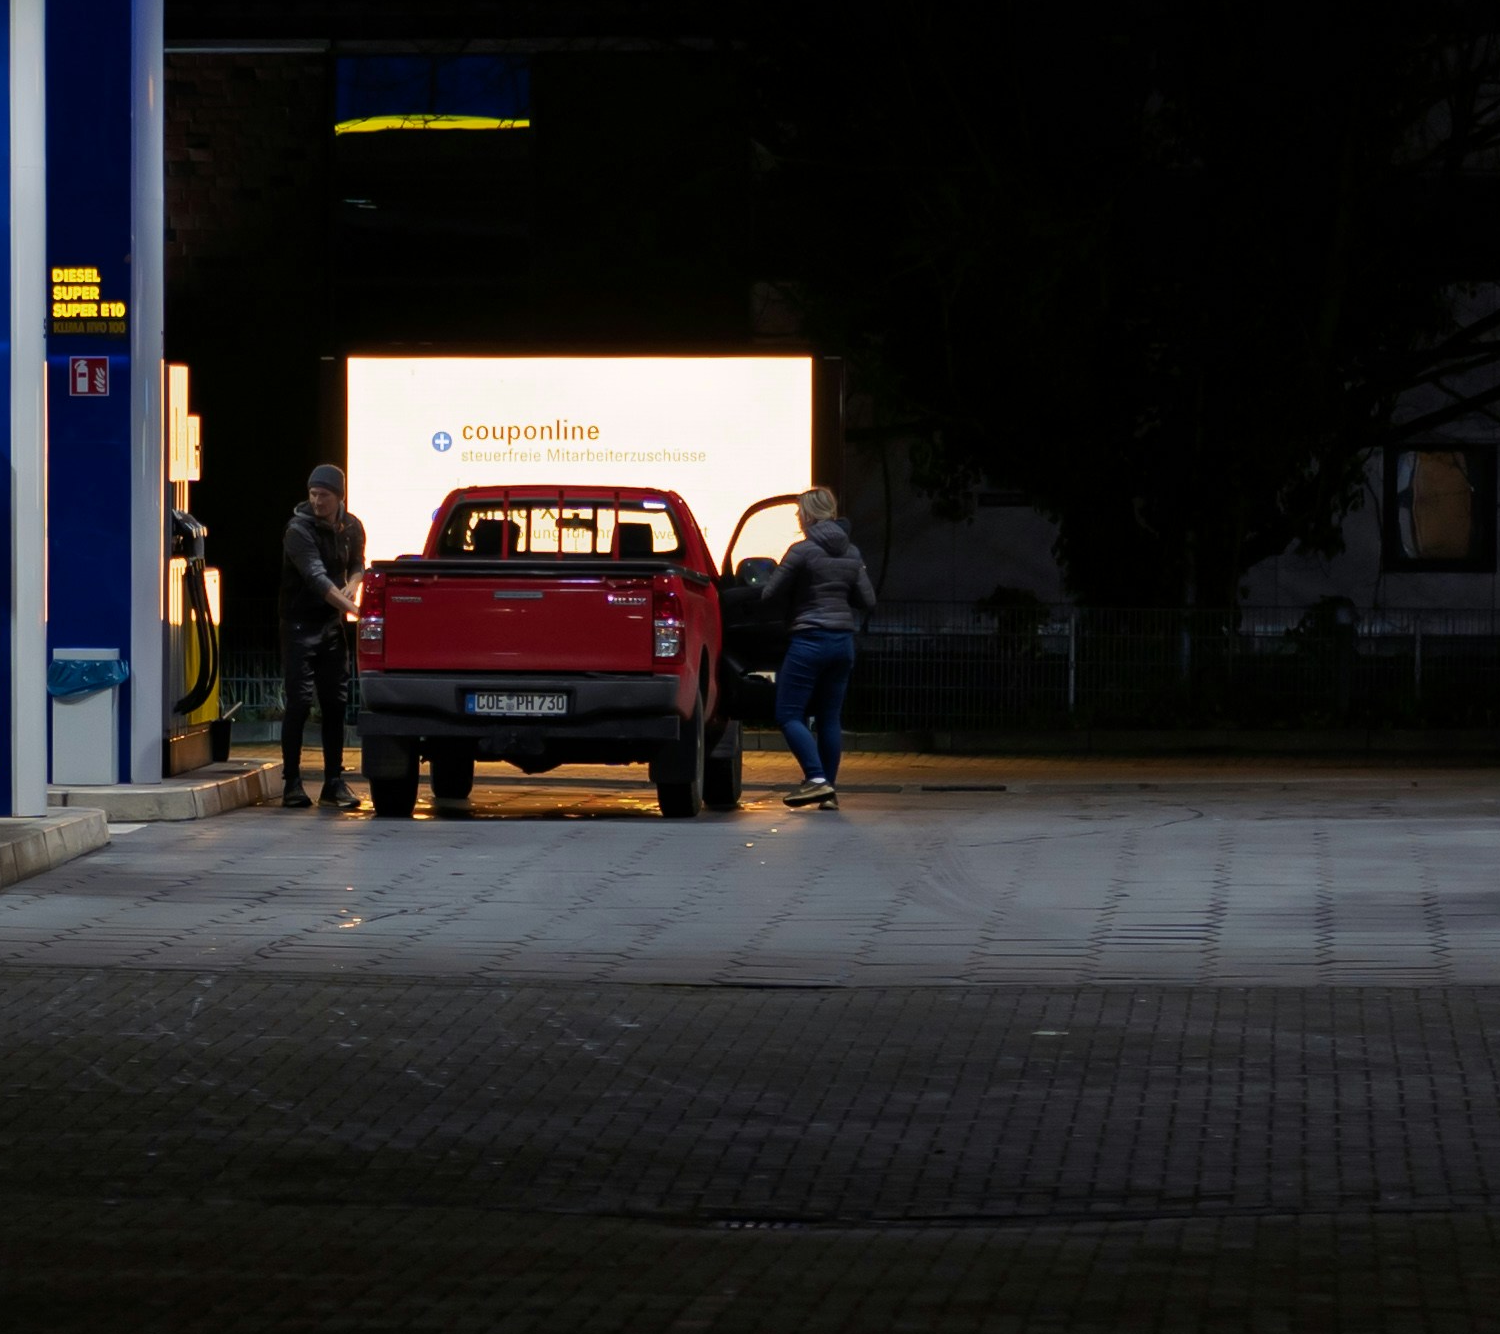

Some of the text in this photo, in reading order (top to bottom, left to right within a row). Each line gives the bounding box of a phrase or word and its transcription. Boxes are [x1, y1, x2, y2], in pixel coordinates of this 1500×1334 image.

[52, 268, 101, 283] DIESEL
[52, 286, 100, 300] SUPER
[52, 303, 126, 317] SUPER E10
[108, 321, 126, 334] 100
[462, 419, 600, 445] couponline
[461, 448, 706, 463] steuerfreie Mitarbeiterzuschüsse
[476, 694, 565, 711] COE PH 730
